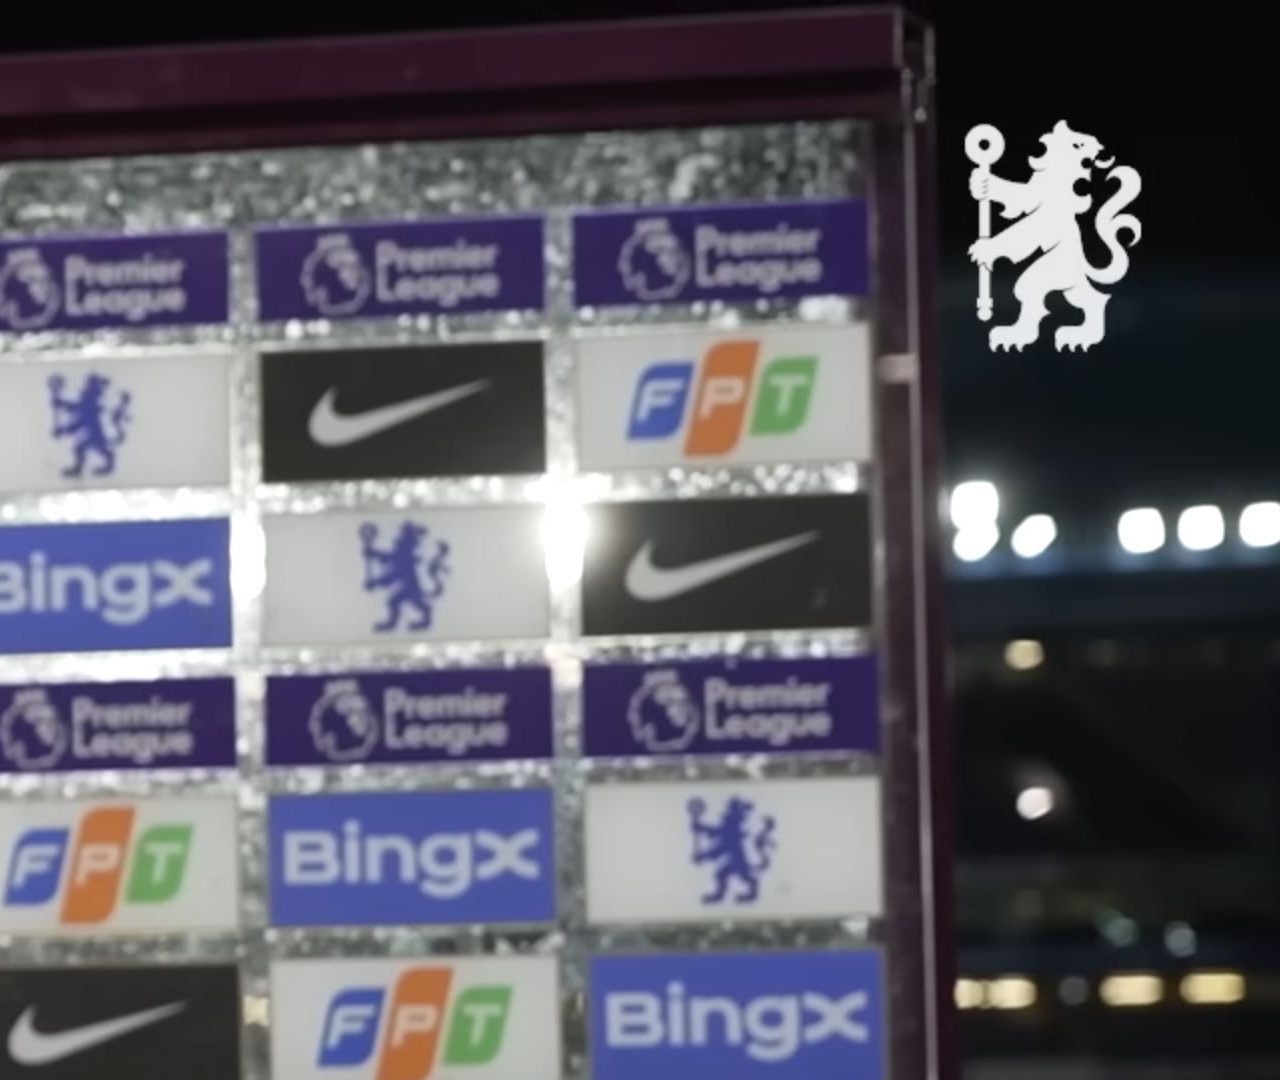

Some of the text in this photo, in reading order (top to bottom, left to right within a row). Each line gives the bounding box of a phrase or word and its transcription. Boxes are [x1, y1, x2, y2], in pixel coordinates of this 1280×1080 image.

[376, 235, 497, 275] Premier
[695, 220, 819, 260] Premier
[65, 250, 183, 290] Premier
[376, 269, 499, 310] League
[695, 254, 821, 298] League
[65, 284, 185, 323] League
[72, 694, 190, 731] Premier
[384, 684, 506, 722] Premier
[704, 674, 828, 712] Premier
[72, 727, 193, 766] League
[384, 718, 507, 757] League
[704, 708, 831, 748] League
